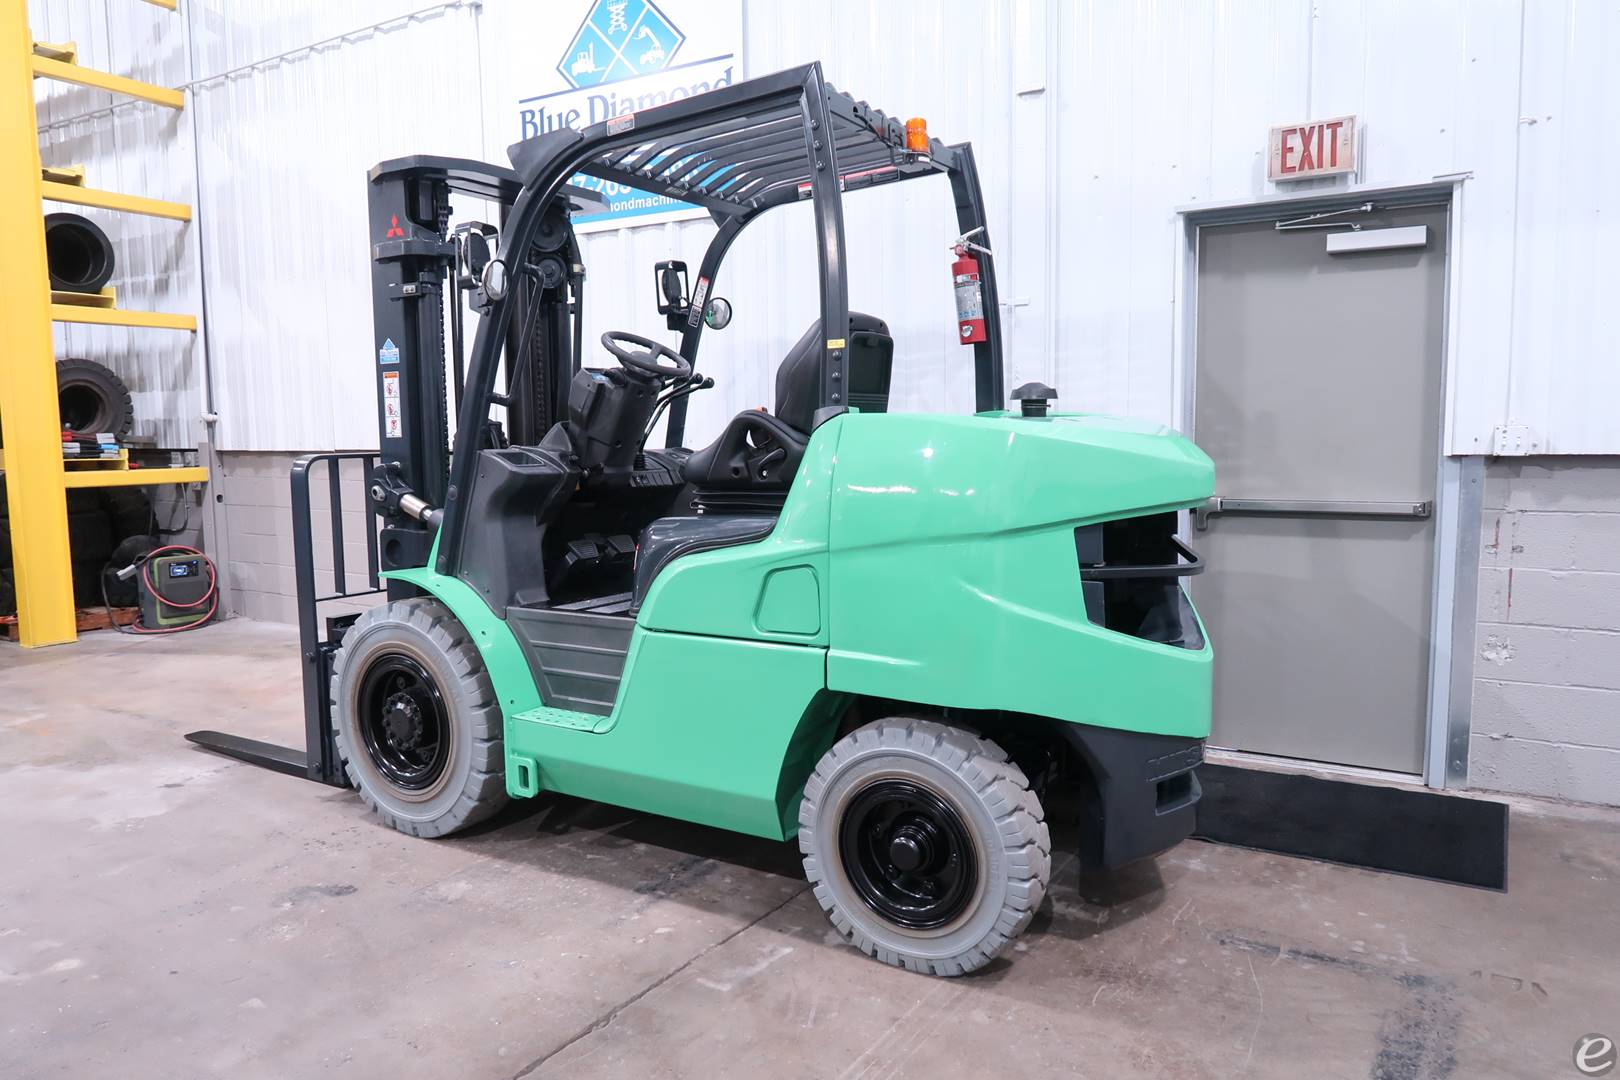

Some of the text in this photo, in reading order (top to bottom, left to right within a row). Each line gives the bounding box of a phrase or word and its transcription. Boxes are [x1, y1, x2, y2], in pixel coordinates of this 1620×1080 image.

[520, 106, 581, 142] Blue
[587, 66, 733, 124] Diamond
[1281, 122, 1343, 174] EXIT
